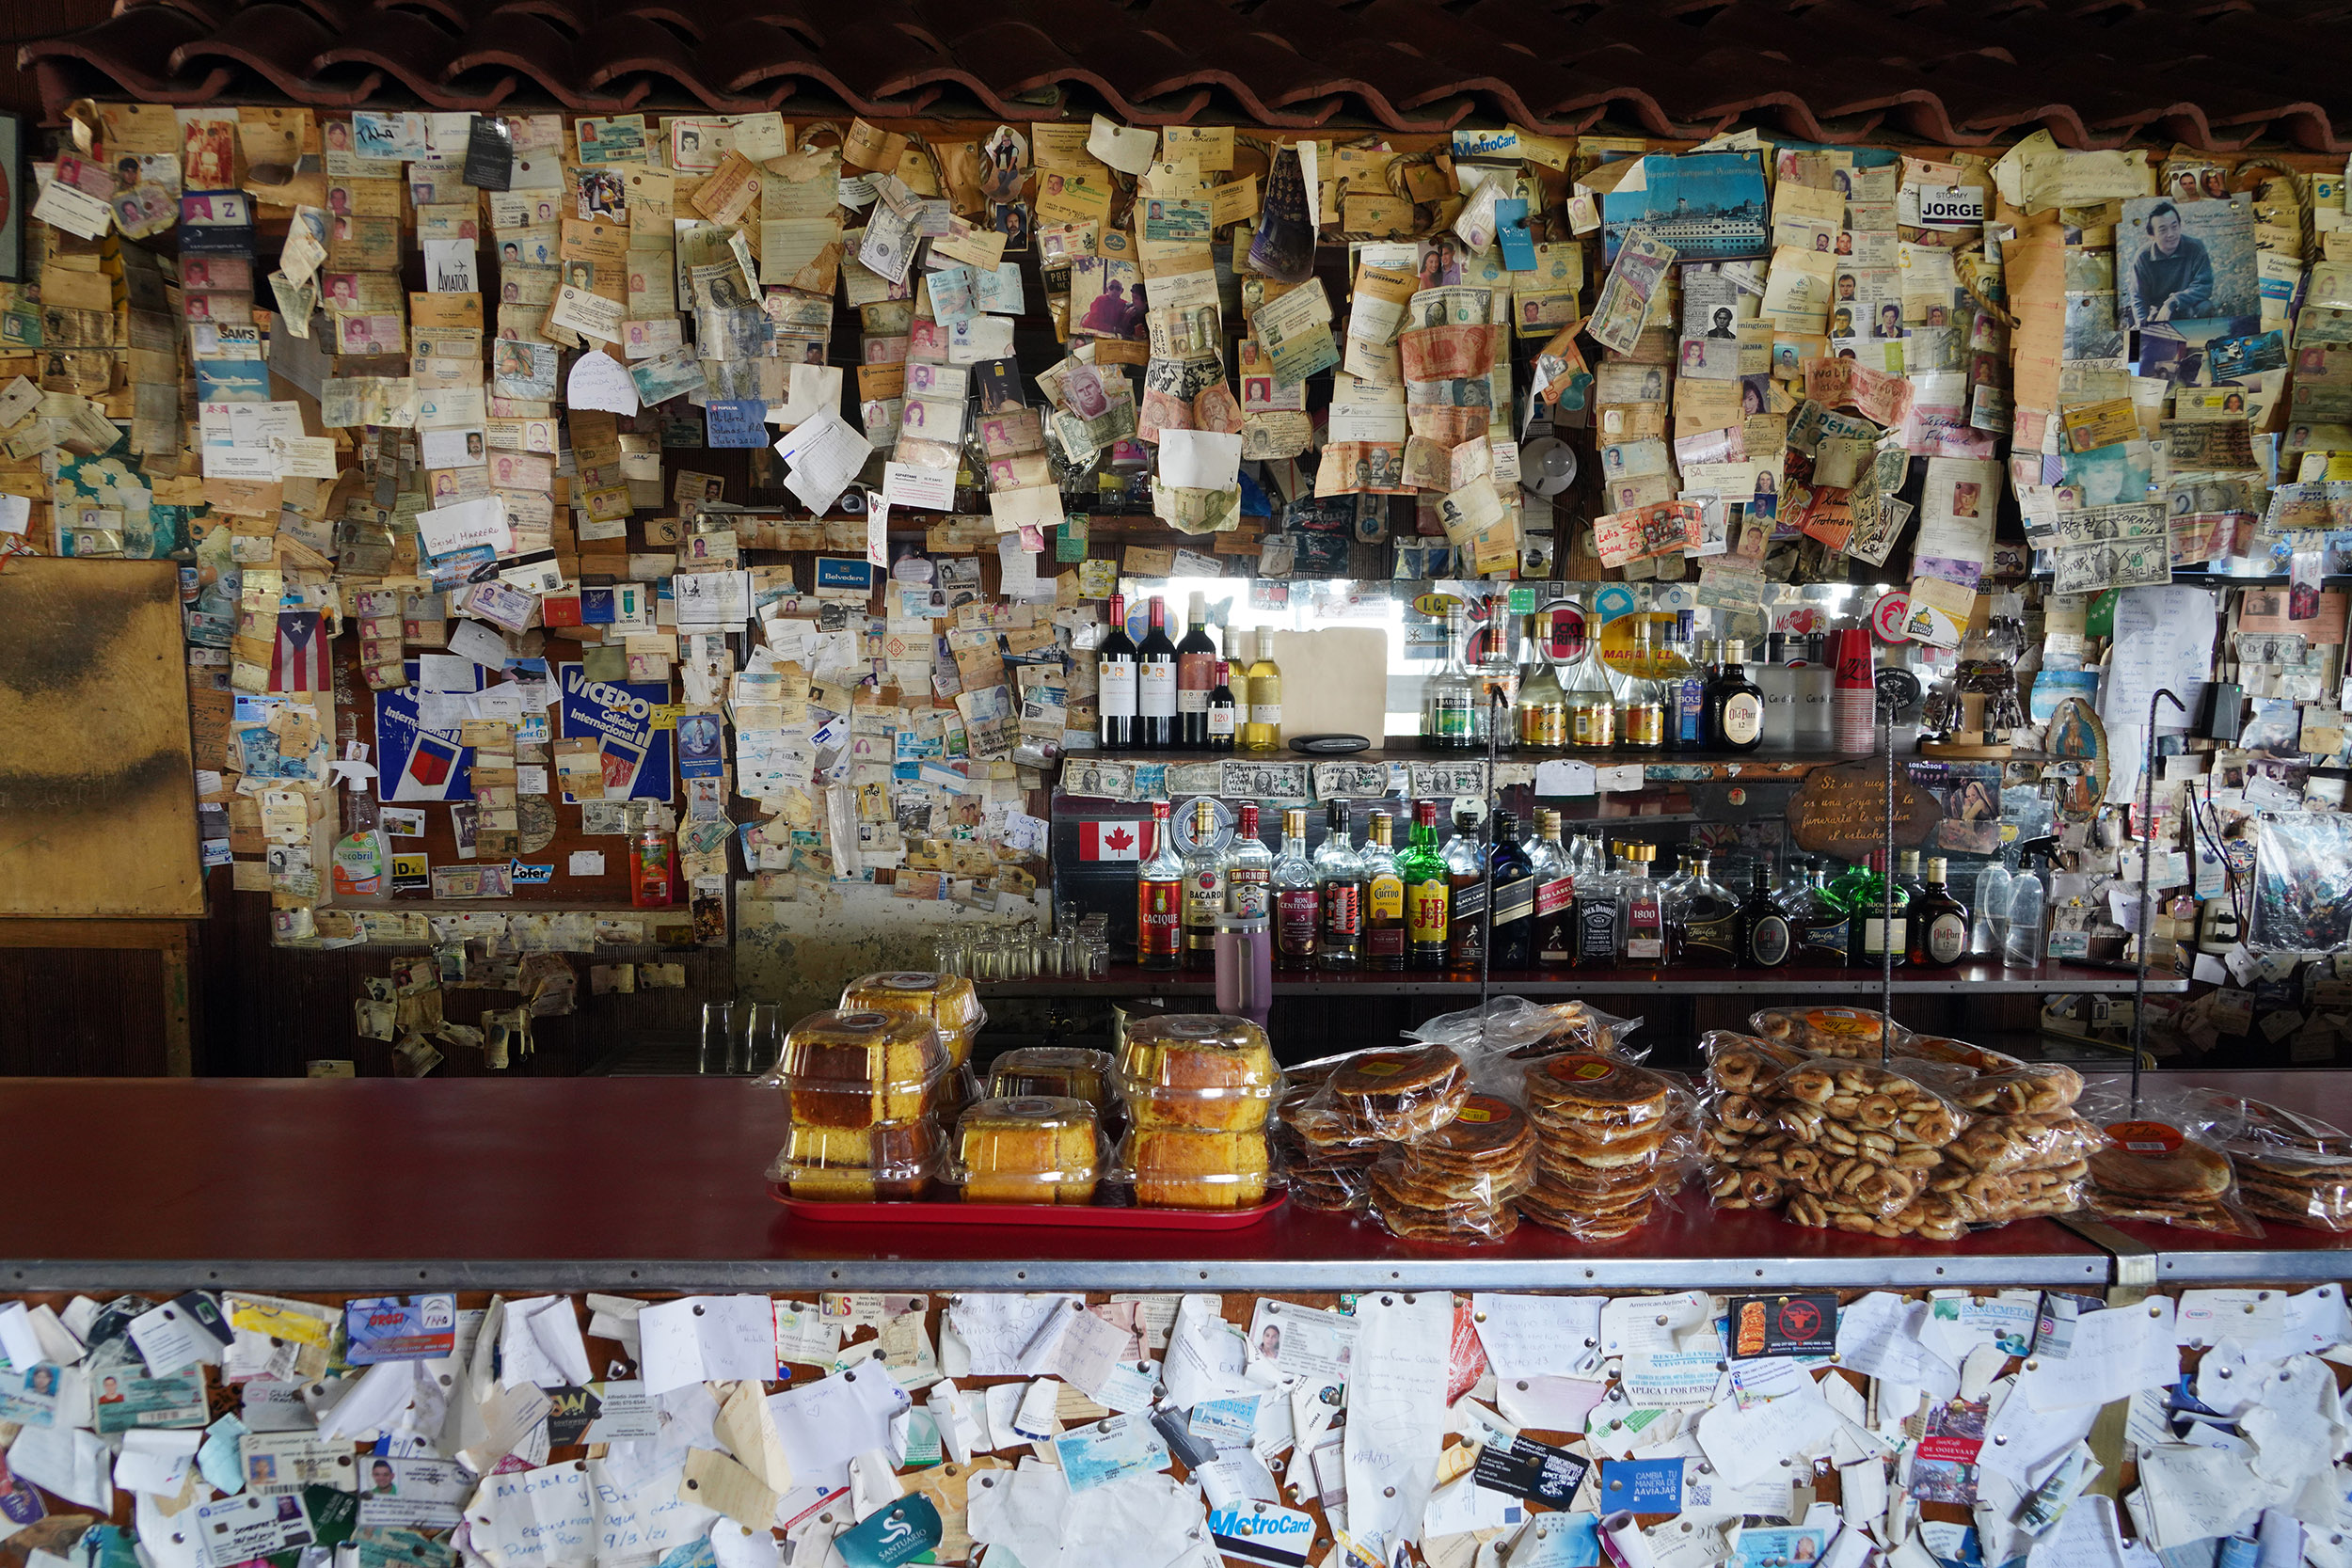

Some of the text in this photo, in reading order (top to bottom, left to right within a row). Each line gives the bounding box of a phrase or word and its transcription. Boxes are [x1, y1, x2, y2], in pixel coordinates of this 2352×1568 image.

[1454, 135, 1517, 157] MetroCard
[222, 202, 235, 217] Z
[1922, 203, 1982, 216] JORGE
[437, 262, 469, 293] AVIATOR
[1050, 272, 1070, 282] PRE
[220, 329, 255, 340] SAM'S
[1172, 340, 1187, 354] 10
[2071, 359, 2122, 369] COSTA RICA
[380, 408, 391, 423] 5
[710, 412, 746, 423] Mildred
[291, 526, 317, 539] Player's
[825, 572, 865, 581] Belvedere
[1550, 622, 1584, 634] UCKY
[1550, 635, 1584, 646] TRIKE
[1679, 695, 1701, 704] BOLS
[1213, 714, 1228, 722] 120
[1728, 708, 1740, 720] Old
[571, 707, 635, 744] Internacional
[601, 710, 640, 733] Calidad
[1820, 775, 1836, 789] Si
[1862, 778, 1898, 791] suega
[863, 787, 880, 797] intel
[1821, 798, 1842, 807] una
[1846, 797, 1871, 810] joya
[1902, 794, 1915, 805] la
[1801, 812, 1852, 828] funeraria
[1873, 810, 1911, 823] veden
[1844, 828, 1885, 840] estuche
[342, 850, 373, 860] ecobril
[511, 860, 547, 878] Lofer
[1232, 871, 1269, 881] SMIRNOFF
[1374, 887, 1400, 898] Cuervo
[1472, 891, 1486, 900] LABE
[1537, 884, 1573, 902] RED LABEL
[1336, 897, 1346, 930] BAMBOO
[1347, 890, 1356, 930] GUARO
[1413, 898, 1446, 929] J&B
[1581, 905, 1596, 918] JACK
[1633, 910, 1656, 919] 1800
[1143, 912, 1178, 926] CACIQUE
[1934, 927, 1947, 940] Old
[1629, 1300, 1661, 1308] American
[369, 1312, 405, 1326] OROSI
[1653, 1352, 1714, 1360] RESTAURANTE
[1630, 1386, 1663, 1395] APLICA
[1635, 1470, 1677, 1481] CAMBIA TU
[1635, 1480, 1664, 1488] MANERA
[1634, 1486, 1677, 1496] AAVIAJAR
[1208, 1509, 1312, 1537] MetroCard
[877, 1528, 928, 1560] SANTUARIO
